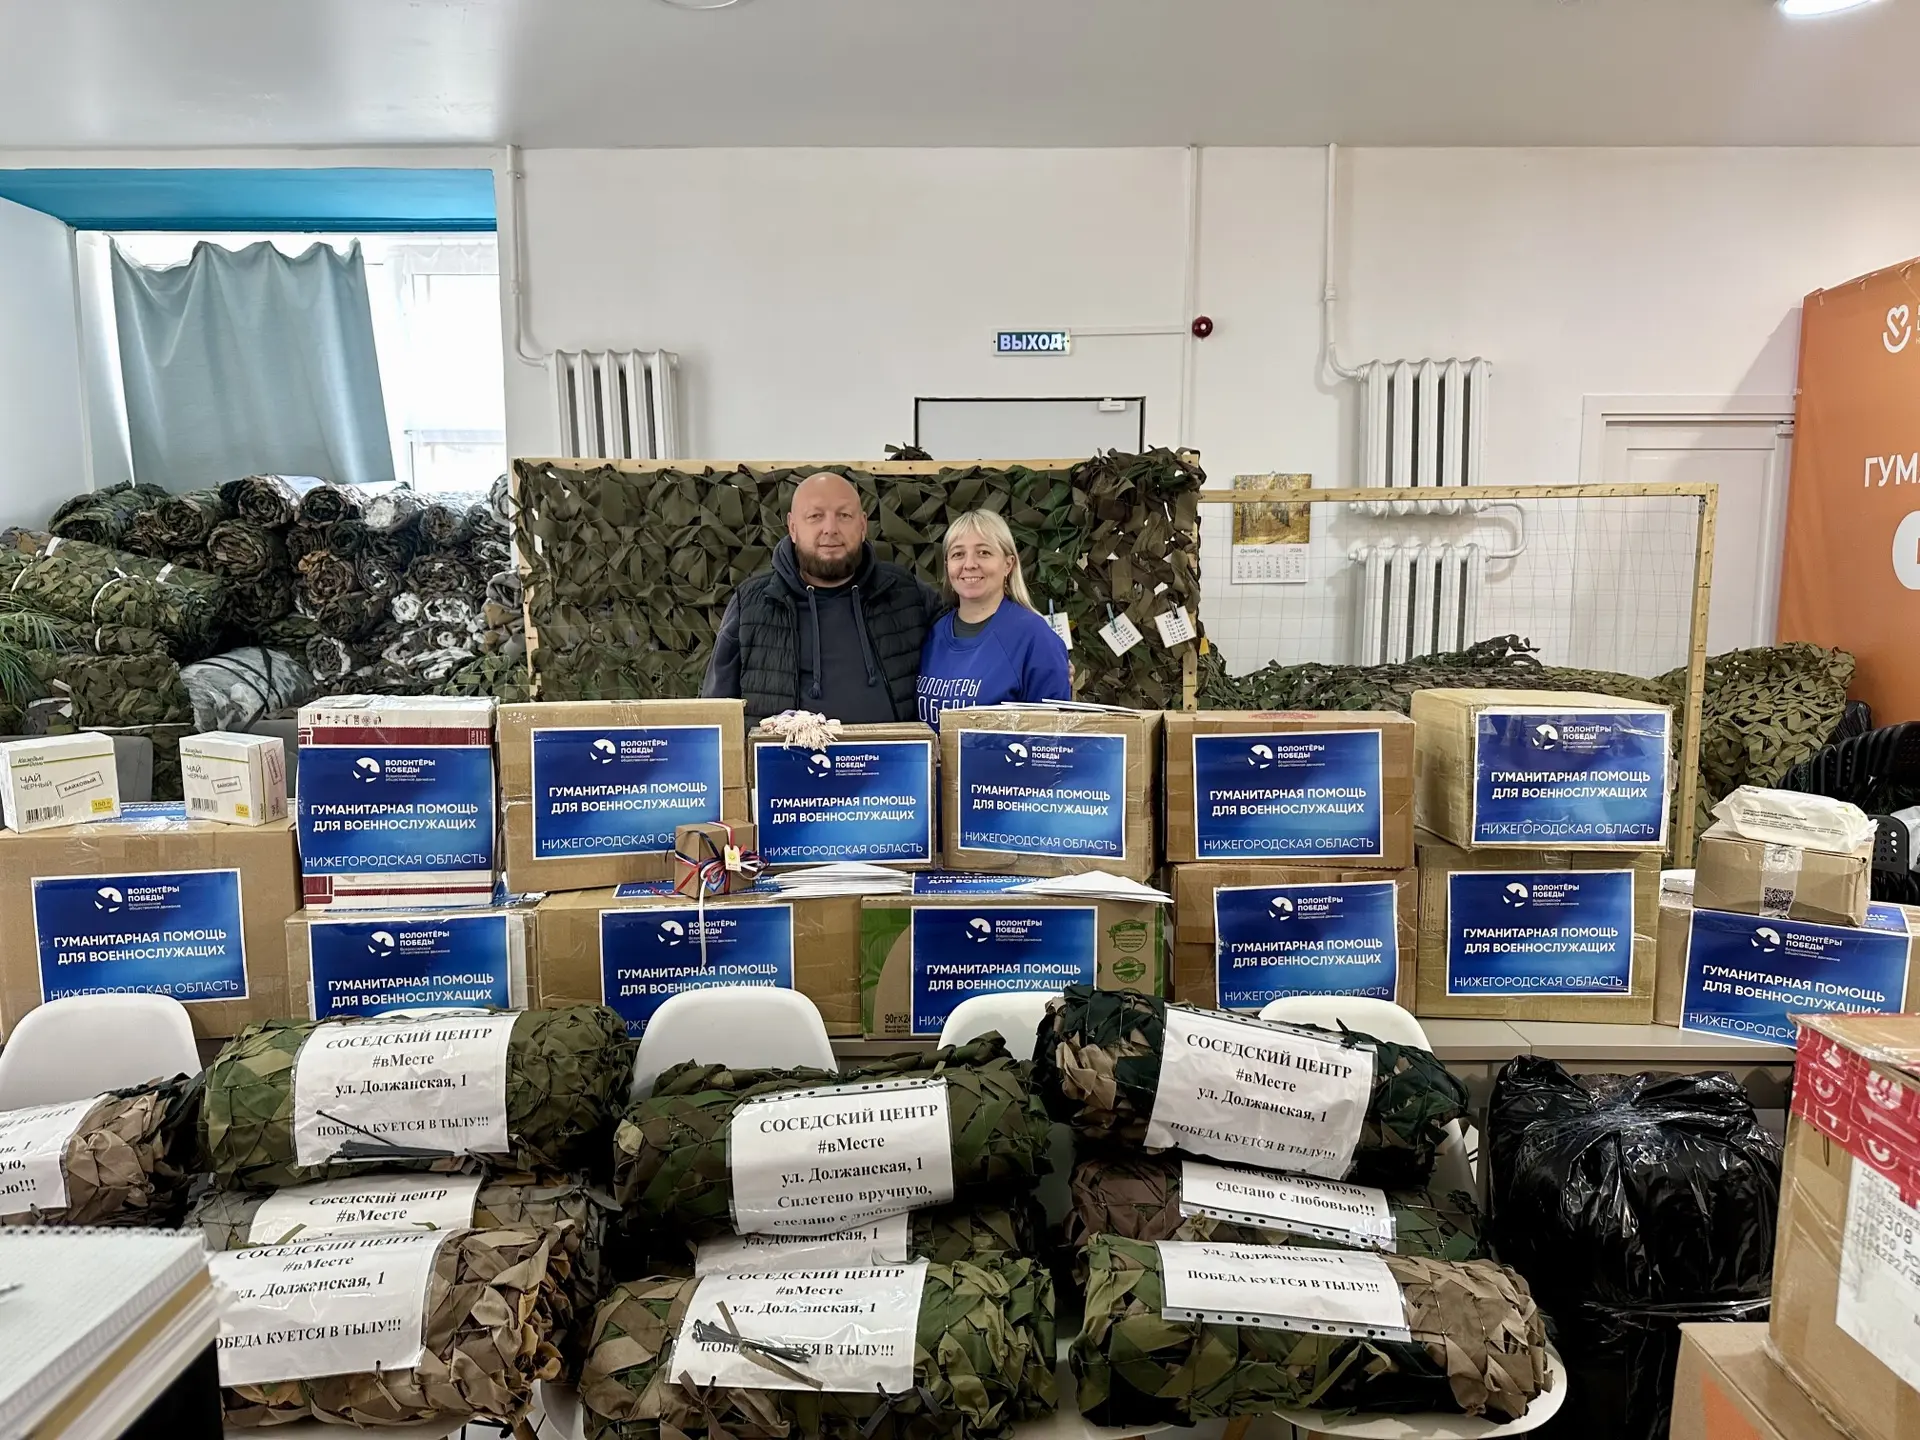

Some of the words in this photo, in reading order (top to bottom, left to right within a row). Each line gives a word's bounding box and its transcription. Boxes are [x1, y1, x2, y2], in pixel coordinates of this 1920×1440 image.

[1000, 334, 1062, 350] ВЫХОД
[1864, 452, 1920, 487] ГУМ
[1032, 752, 1060, 760] ПОБЕДЫ
[187, 764, 201, 773] ЧАЙ
[20, 773, 41, 783] ЧАЙ
[1491, 772, 1586, 782] ГУМАНИТАРНАЯ
[1590, 771, 1650, 782] ПОМОЩЬ
[21, 780, 52, 790] ЧЕРНЫЙ
[549, 784, 647, 797] ГУМАНИТАРНАЯ
[651, 782, 707, 794] ПОМОЩЬ
[971, 784, 1053, 798] ГУМАНИТАРНАЯ
[1057, 789, 1110, 801] ПОМОЩЬ
[1210, 789, 1304, 800] ГУМАНИТАРНАЯ
[1308, 788, 1366, 798] ПОМОЩЬ
[1492, 788, 1518, 799] ДЛЯ
[1522, 787, 1647, 798] ВОЕННОСЛУЖАЩИХ
[311, 805, 413, 815] ГУМАНИТАРНАЯ
[417, 803, 478, 815] ПОМОЩЬ
[552, 802, 578, 814] ДЛЯ
[582, 797, 706, 811] ВОЕННОСЛУЖАЩИХ
[771, 797, 859, 808] ГУМАНИТАРНАЯ
[863, 796, 916, 807] ПОМОЩЬ
[973, 799, 994, 810] ДЛЯ
[997, 802, 1108, 816] ВОЕННОСЛУЖАЩИХ
[773, 813, 796, 824] ДЛЯ
[800, 810, 914, 822] ВОЕННОСЛУЖАЩИХ
[1212, 805, 1236, 817] ДЛЯ
[1240, 803, 1364, 815] ВОЕННОСЛУЖАЩИХ
[313, 820, 340, 832] ДЛЯ
[344, 819, 476, 830] ВОЕННОСЛУЖАЩИХ
[1481, 824, 1591, 835] НИЖЕГОРОДСКАЯ
[1595, 824, 1654, 834] ОБЛАСТЬ
[542, 834, 654, 849] НИЖЕГОРОДСКАЯ
[965, 832, 1060, 847] НИЖЕГОРОДСКАЯ
[1063, 838, 1116, 850] ОБЛАСТЬ
[1204, 839, 1312, 850] НИЖЕГОРОДСКАЯ
[1315, 838, 1374, 848] ОБЛАСТЬ
[764, 845, 866, 856] НИЖЕГОРОДСКАЯ
[870, 843, 923, 853] ОБЛАСТЬ
[305, 855, 422, 867] НИЖЕГОРОДСКАЯ
[426, 854, 486, 864] ОБЛАСТЬ
[54, 934, 160, 947] ГУМАНИТАРНАЯ
[164, 929, 226, 942] ПОМОЩЬ
[1464, 929, 1557, 938] ГУМАНИТАРНАЯ
[1561, 928, 1618, 938] ПОМОЩЬ
[1232, 940, 1324, 952] ГУМАНИТАРНАЯ
[1327, 938, 1382, 950] ПОМОЩЬ
[1465, 944, 1490, 954] ДЛЯ
[1494, 943, 1616, 953] ВОЕННОСЛУЖАЩИХ
[1786, 940, 1824, 950] ПОБЕДЫ
[58, 951, 86, 965] ДЛЯ
[90, 945, 225, 962] ВОЕННОСЛУЖАЩИХ
[1233, 957, 1258, 968] ДЛЯ
[1261, 954, 1382, 966] ВОЕННОСЛУЖАЩИХ
[618, 966, 715, 979] ГУМАНИТАРНАЯ
[720, 964, 777, 975] ПОМОЩЬ
[927, 964, 1020, 975] ГУМАНИТАРНАЯ
[1024, 964, 1081, 975] ПОМОЩЬ
[175, 980, 238, 994] ОБЛАСТЬ
[328, 976, 429, 991] ГУМАНИТАРНАЯ
[433, 973, 494, 985] ПОМОЩЬ
[928, 980, 952, 992] ДЛЯ
[1455, 977, 1562, 987] НИЖЕГОРОДСКАЯ
[1566, 976, 1622, 986] ОБЛАСТЬ
[1703, 965, 1812, 991] ГУМАНИТАРНАЯ
[1815, 983, 1885, 1002] ПОМОЩЬ
[1703, 981, 1731, 993] ДЛЯ
[620, 984, 646, 997] ДЛЯ
[332, 996, 358, 1008] ДЛЯ
[362, 989, 492, 1005] ВОЕННОСЛУЖАЩИХ
[326, 1032, 434, 1050] СОСЕДСКИЙ
[436, 1028, 492, 1043] ЦЕНТР
[372, 1053, 434, 1069] #вМесте
[1186, 1033, 1291, 1067] СОСЕДСКИЙ
[1296, 1056, 1352, 1080] ЦЕНТР
[335, 1081, 357, 1097] ул.
[361, 1076, 456, 1095] Должанская,
[460, 1074, 467, 1087] 1
[1235, 1068, 1297, 1093] #вМесте
[1197, 1085, 1219, 1102] ул.
[1221, 1091, 1317, 1123] Должанская,
[1321, 1110, 1327, 1122] 1
[372, 1119, 425, 1134] КУЕТСЯ
[428, 1119, 436, 1129] В
[438, 1116, 489, 1130] ТЫЛУ!!!
[760, 1108, 875, 1134] СОСЕДСКИЙ
[879, 1104, 938, 1123] ЦЕНТР
[817, 1135, 885, 1155] #вМесте
[1171, 1122, 1221, 1140] ПОБЕДА
[1224, 1133, 1274, 1150] КУЕТСЯ
[1277, 1142, 1286, 1152] В
[1288, 1145, 1336, 1162] ТЫЛУ!!!
[781, 1171, 804, 1188] ул.
[808, 1161, 912, 1184] Должанская,
[916, 1157, 922, 1170] 1
[309, 1193, 396, 1205] Соседский
[401, 1189, 447, 1202] центр
[777, 1190, 854, 1210] Сплетено
[859, 1182, 932, 1203] вручную,
[1216, 1181, 1275, 1199] сделано
[1280, 1192, 1287, 1201] с
[1291, 1195, 1376, 1216] любовью!!!
[336, 1209, 407, 1223] #вМесте
[773, 1216, 835, 1227] сделано
[839, 1215, 847, 1223] с
[873, 1228, 878, 1239] 1
[236, 1240, 355, 1260] СОСЕДСКИЙ
[283, 1256, 354, 1272] #вМесте
[376, 1271, 385, 1285] 1
[727, 1270, 839, 1280] СОСЕДСКИЙ
[844, 1270, 904, 1280] ЦЕНТР
[1188, 1270, 1246, 1283] ПОБЕДА
[1251, 1277, 1307, 1287] КУЕТСЯ
[1311, 1280, 1320, 1288] В
[1323, 1282, 1380, 1292] ТЫЛУ!!!
[776, 1286, 843, 1295] #вМесте
[731, 1304, 754, 1315] ул.
[870, 1303, 876, 1312] 1
[266, 1326, 325, 1344] КУЕТСЯ
[330, 1325, 338, 1337] В
[343, 1319, 401, 1337] ТЫЛУ!!!
[825, 1344, 833, 1355] В
[838, 1344, 894, 1356] ТЫЛУ!!!
